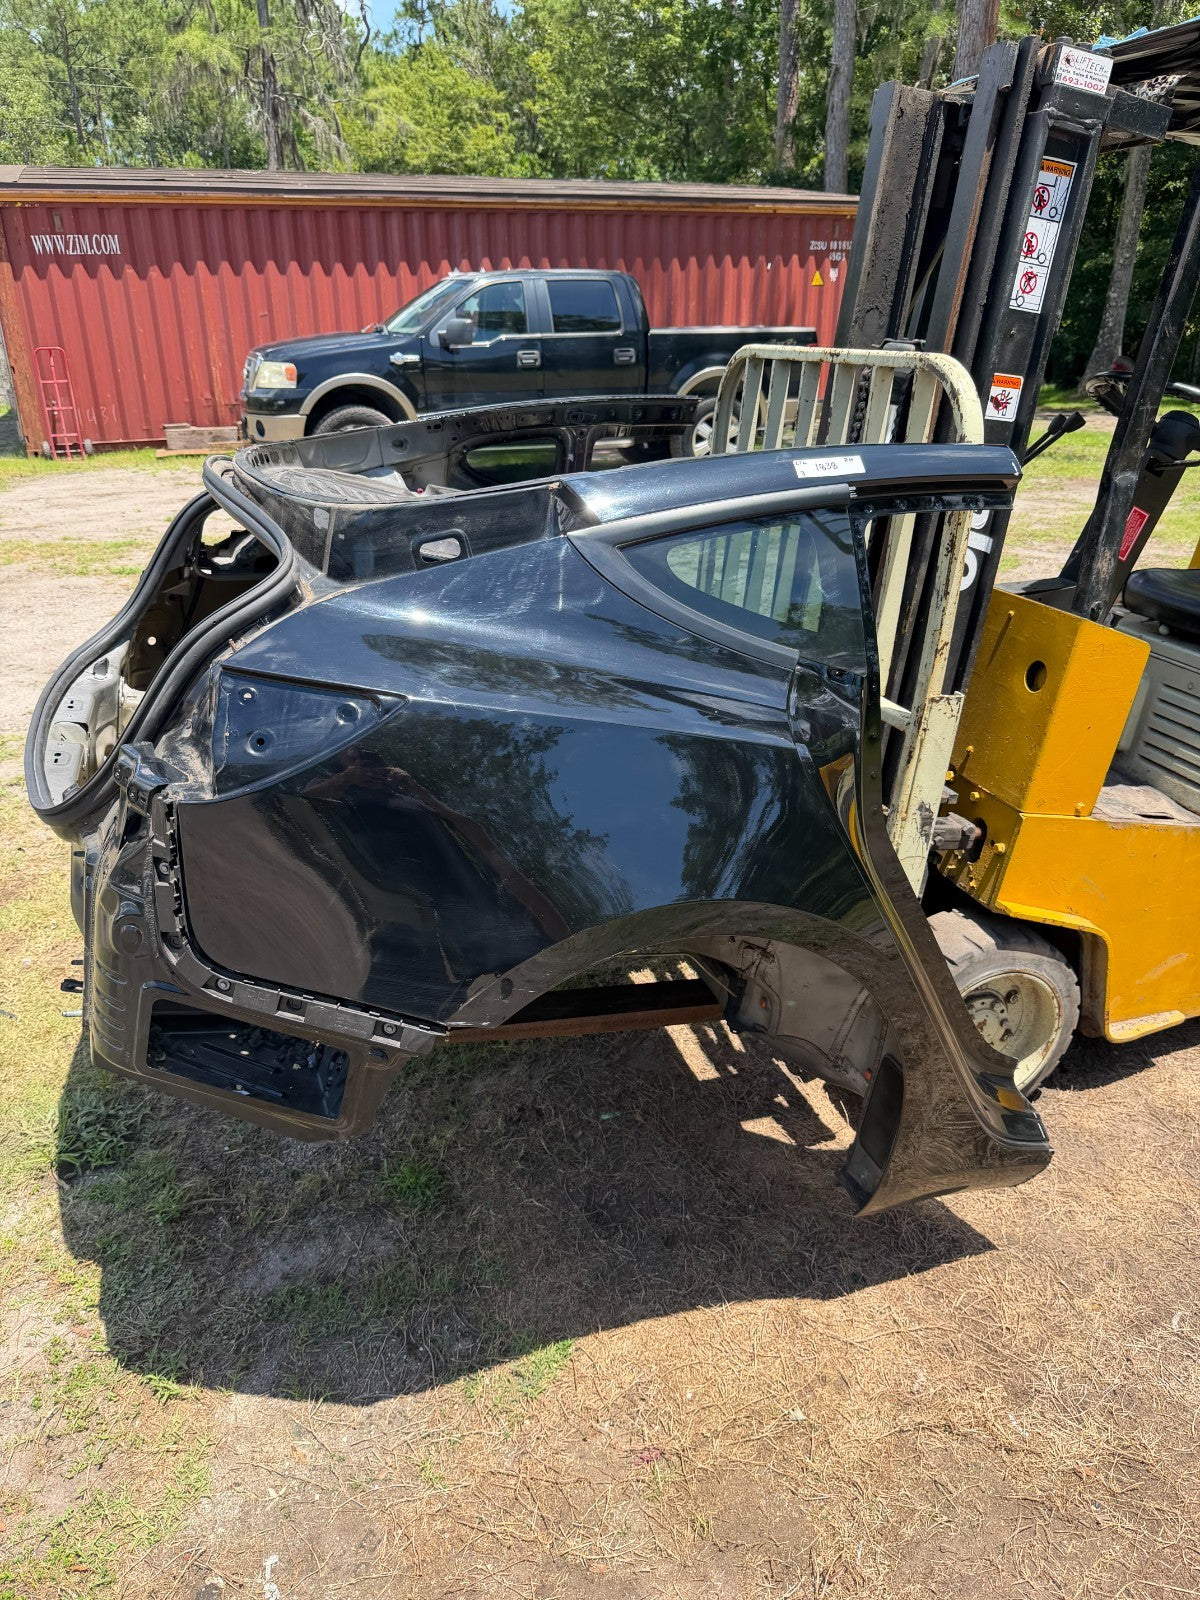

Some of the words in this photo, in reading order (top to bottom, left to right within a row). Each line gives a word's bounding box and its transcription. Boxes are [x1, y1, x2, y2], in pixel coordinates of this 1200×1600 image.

[1062, 76, 1104, 92] 693-1007
[1045, 164, 1071, 176] WARNING
[30, 234, 121, 255] WWW.ZIM.COM
[996, 379, 1019, 387] WARNING
